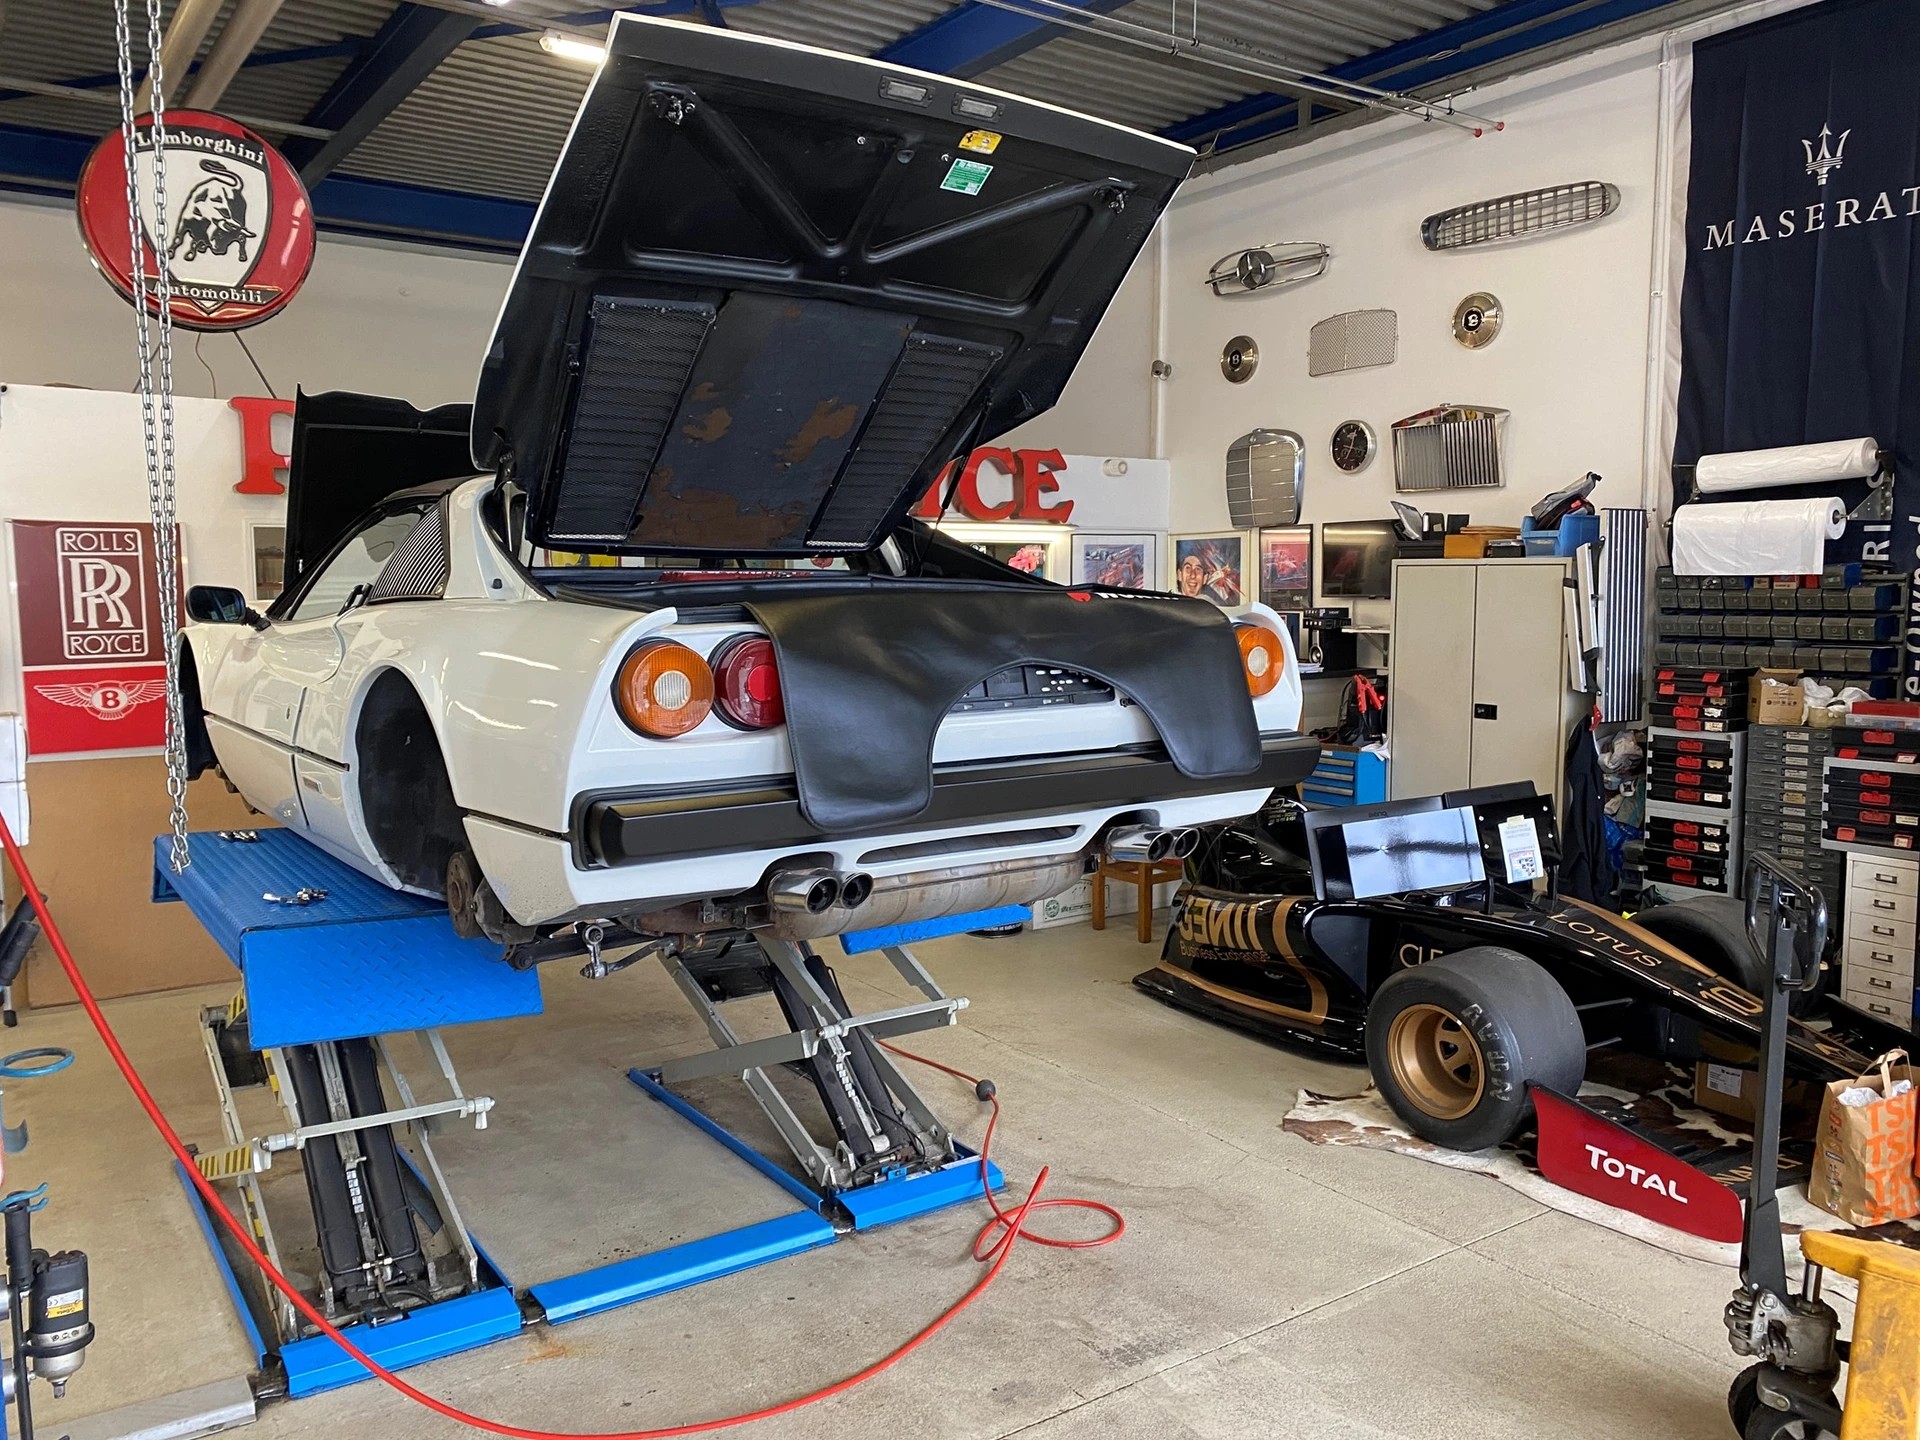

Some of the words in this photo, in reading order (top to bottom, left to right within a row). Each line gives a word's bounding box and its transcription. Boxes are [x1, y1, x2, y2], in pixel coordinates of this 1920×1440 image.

[137, 131, 266, 165] Lmborghini
[63, 532, 137, 552] ROLLS
[70, 634, 143, 655] ROYCE
[1179, 940, 1218, 960] Business
[1214, 947, 1271, 962] Exchange
[1547, 912, 1663, 968] LOTUS
[1585, 1143, 1688, 1204] TOTAL
